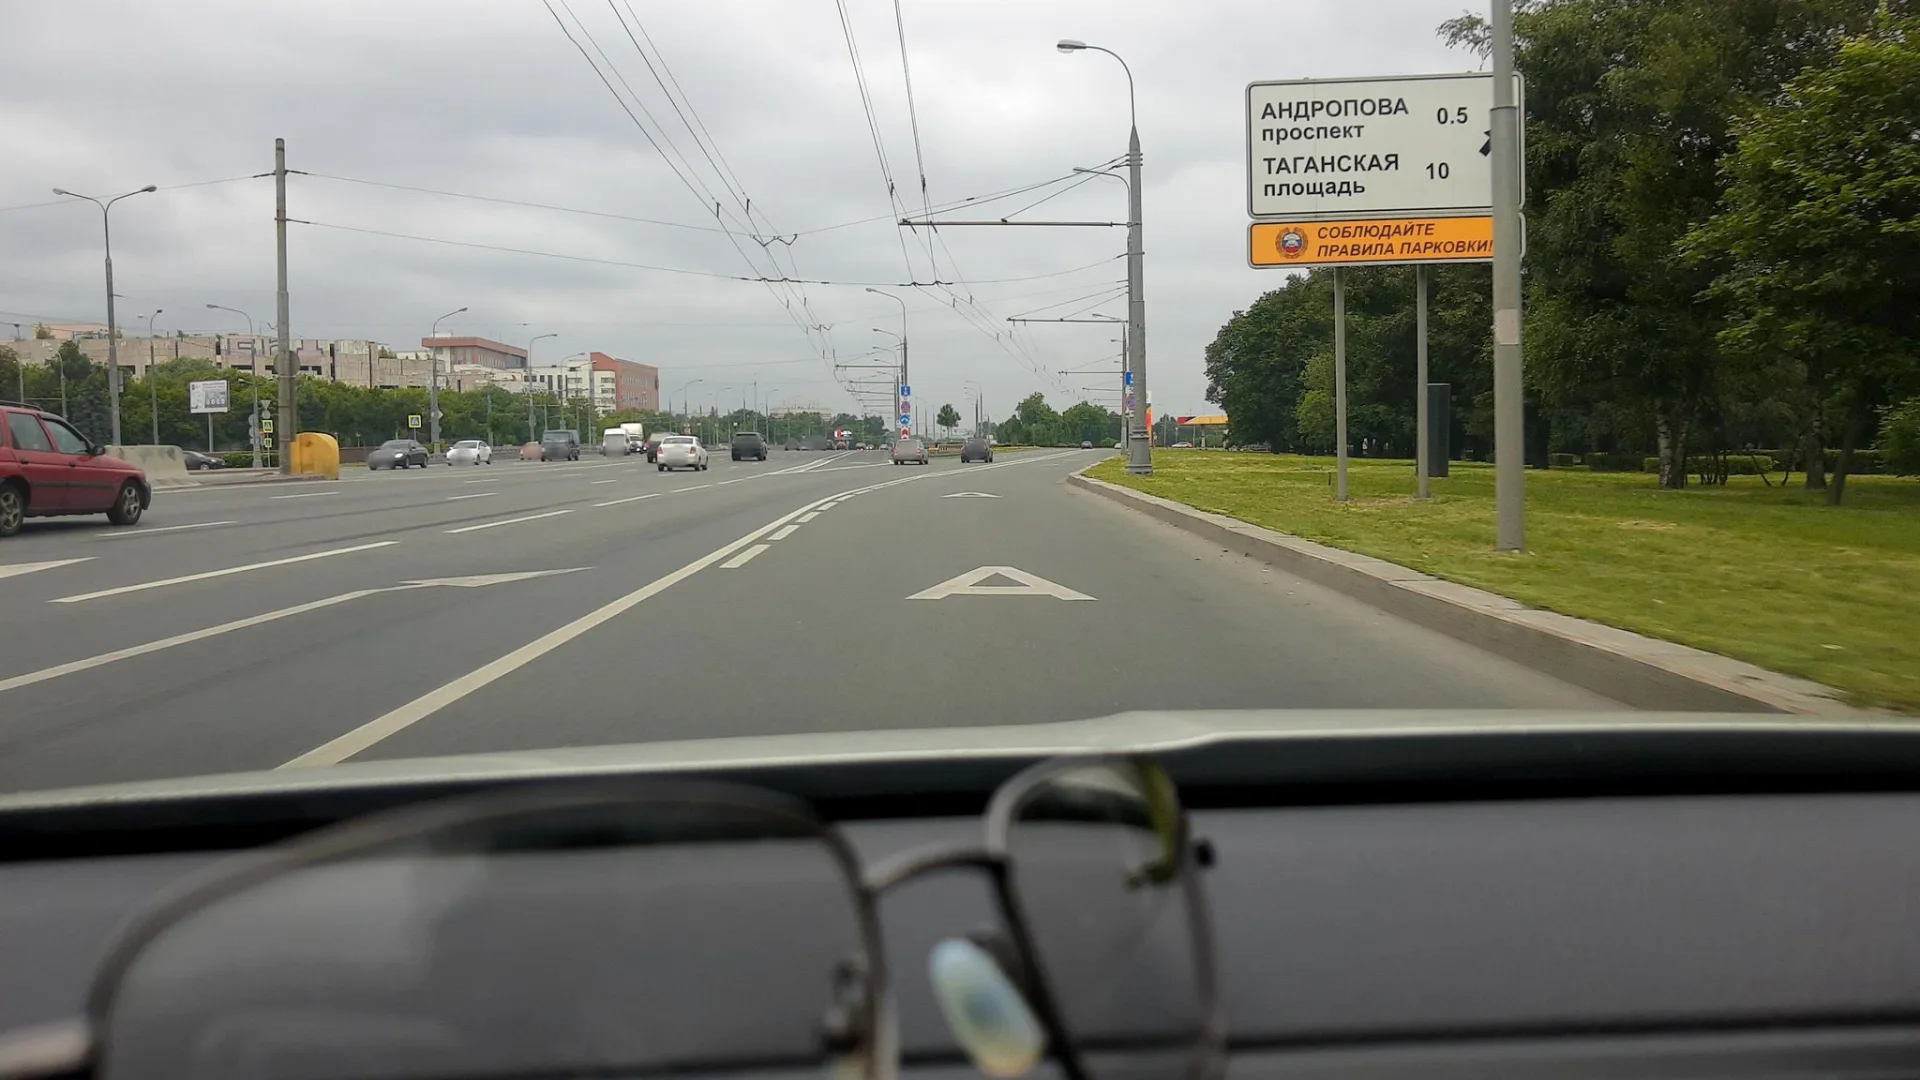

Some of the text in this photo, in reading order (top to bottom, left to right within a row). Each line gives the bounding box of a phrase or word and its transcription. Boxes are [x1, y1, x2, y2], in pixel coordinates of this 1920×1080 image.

[1261, 98, 1468, 124] АНДРОПОВА 0.5
[1262, 125, 1364, 144] проспект
[1263, 154, 1449, 180] ТАГАНСКАЯ 10
[1264, 181, 1365, 197] площадь
[1317, 222, 1435, 240] СОБЛЮДАЙТЕ
[1317, 240, 1493, 257] ПРАВИЛА ПАРКОВКИ!
